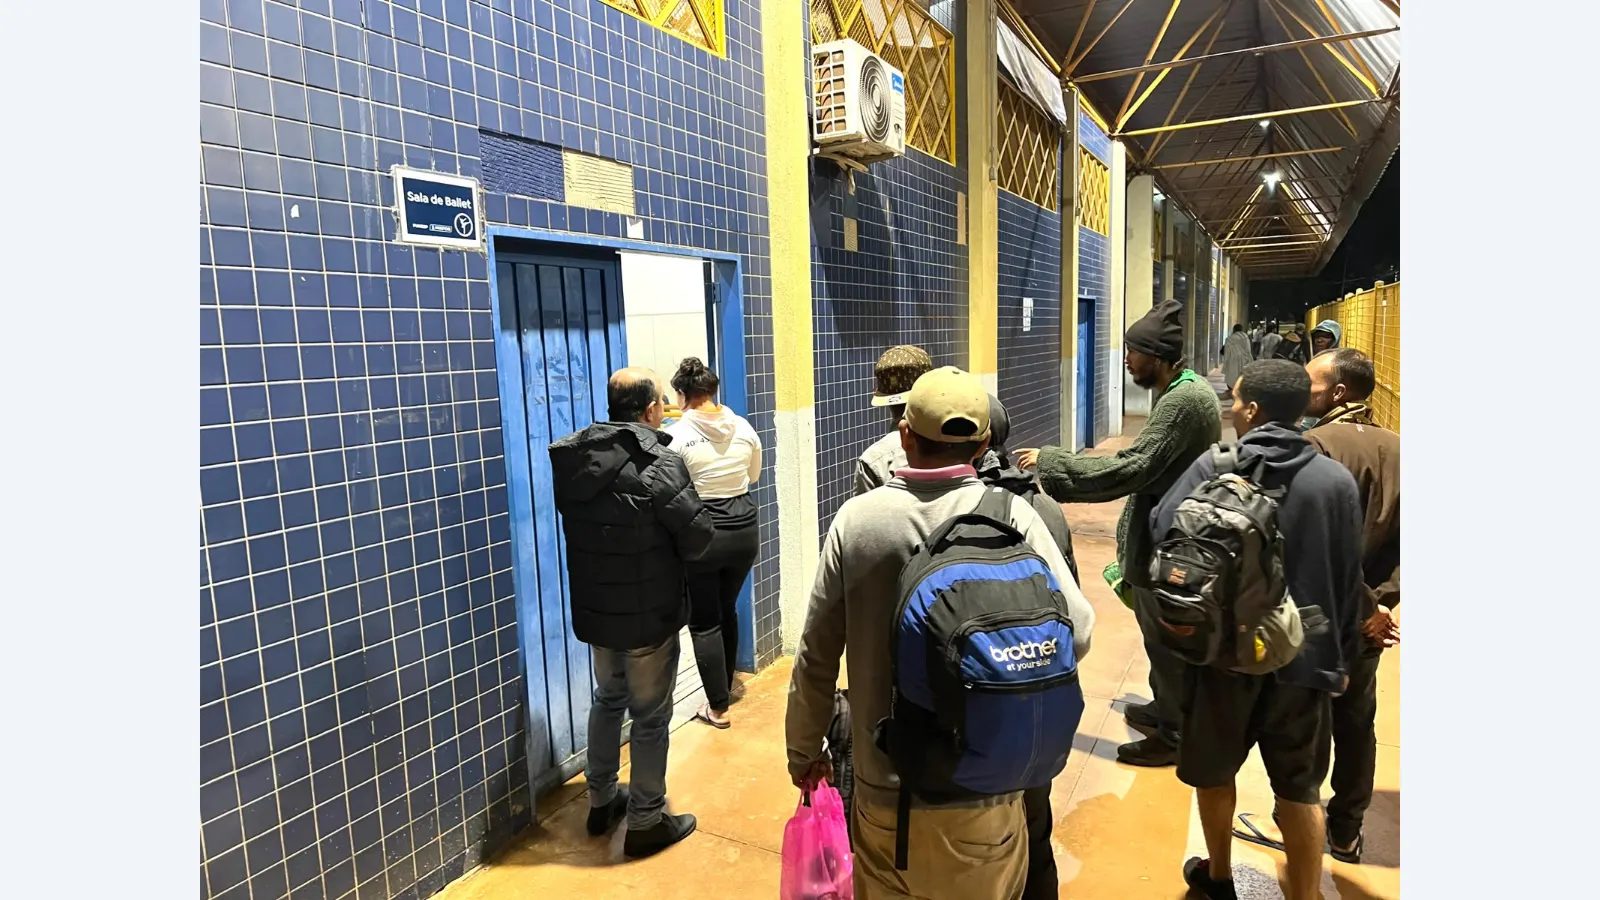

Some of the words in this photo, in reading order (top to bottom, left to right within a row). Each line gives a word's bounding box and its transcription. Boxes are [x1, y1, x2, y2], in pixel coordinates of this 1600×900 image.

[407, 190, 429, 204] Sala
[430, 194, 444, 206] de
[445, 196, 472, 209] Ballet
[989, 637, 1058, 663] brother
[1006, 663, 1016, 671] at
